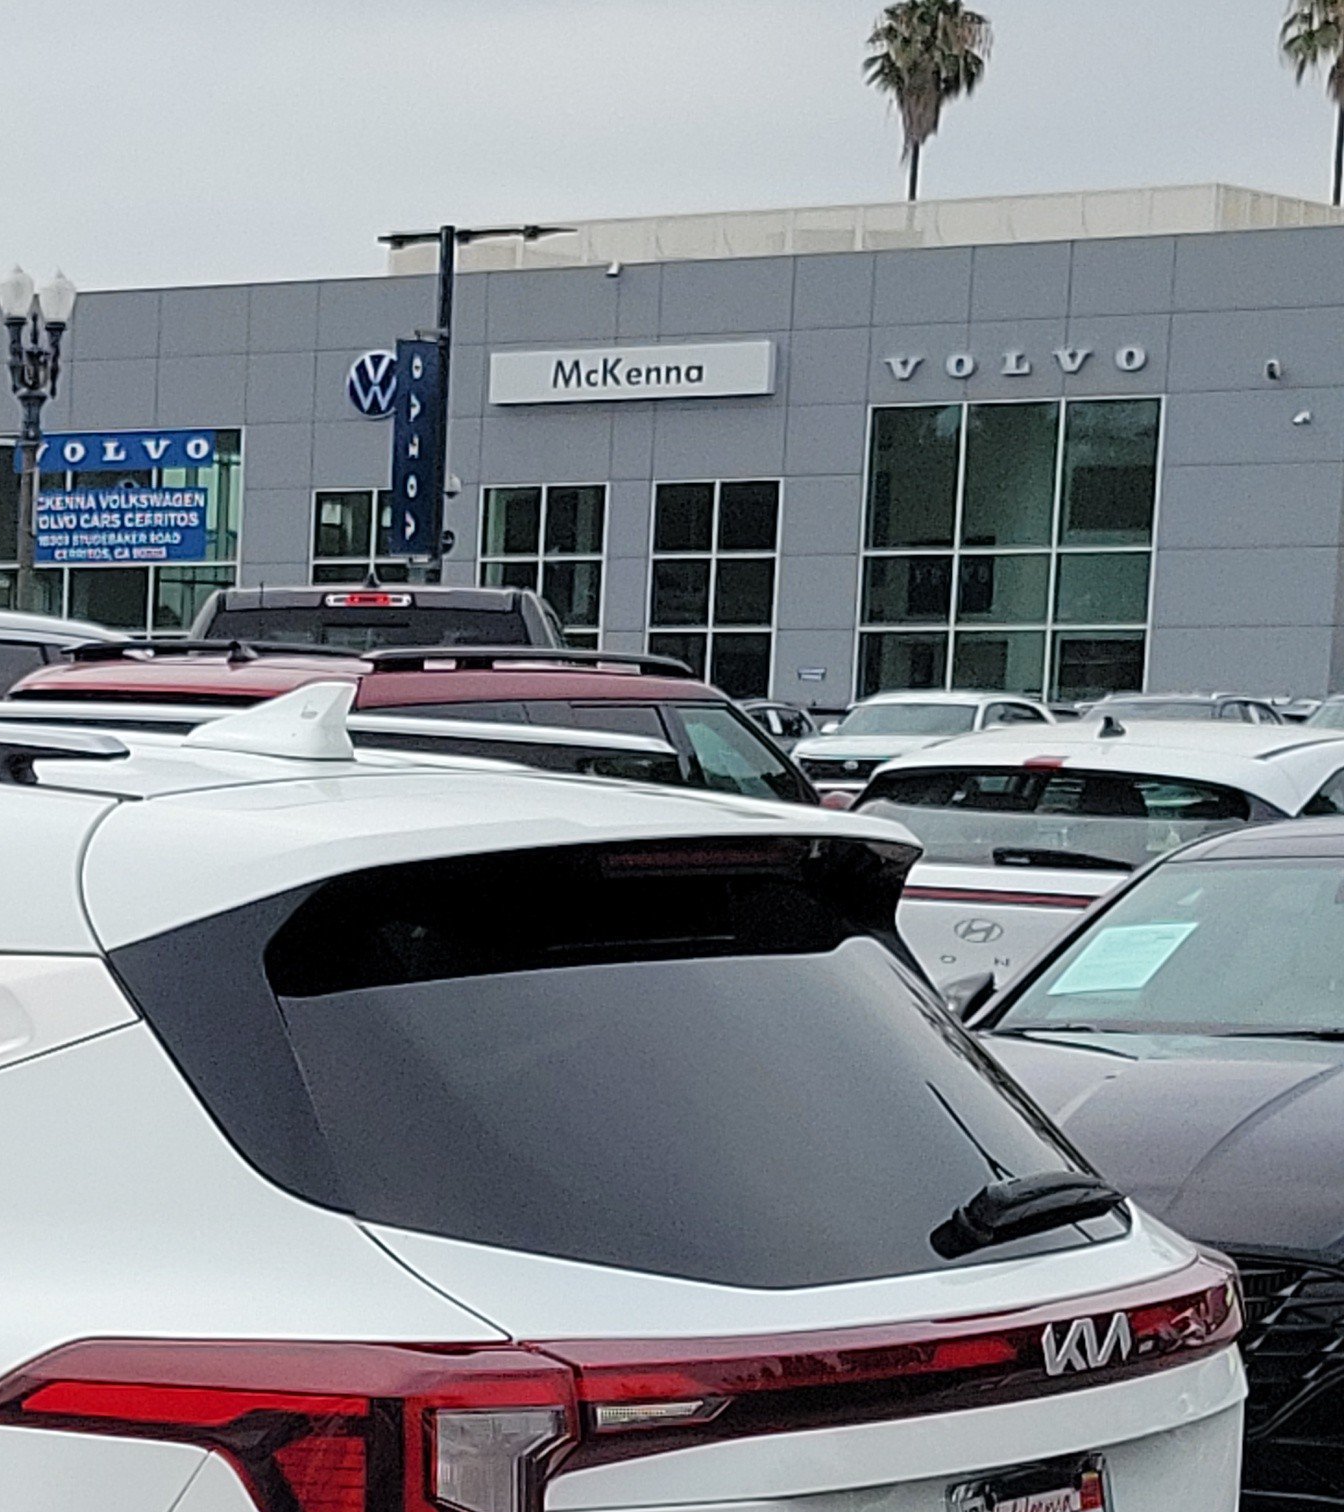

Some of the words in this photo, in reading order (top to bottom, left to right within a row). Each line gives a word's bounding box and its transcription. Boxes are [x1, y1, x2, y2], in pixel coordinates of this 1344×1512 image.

[552, 357, 704, 388] McKenna
[884, 347, 1147, 381] VOLVO
[404, 354, 423, 541] VOLVO
[98, 490, 205, 509] VOLKSWAGEN
[38, 513, 77, 530] OLVO
[79, 512, 121, 529] CARS
[124, 510, 200, 528] CERRITOS
[72, 531, 147, 547] STUDEBAKER
[150, 530, 181, 545] ROAD
[1040, 1312, 1132, 1377] KIA
